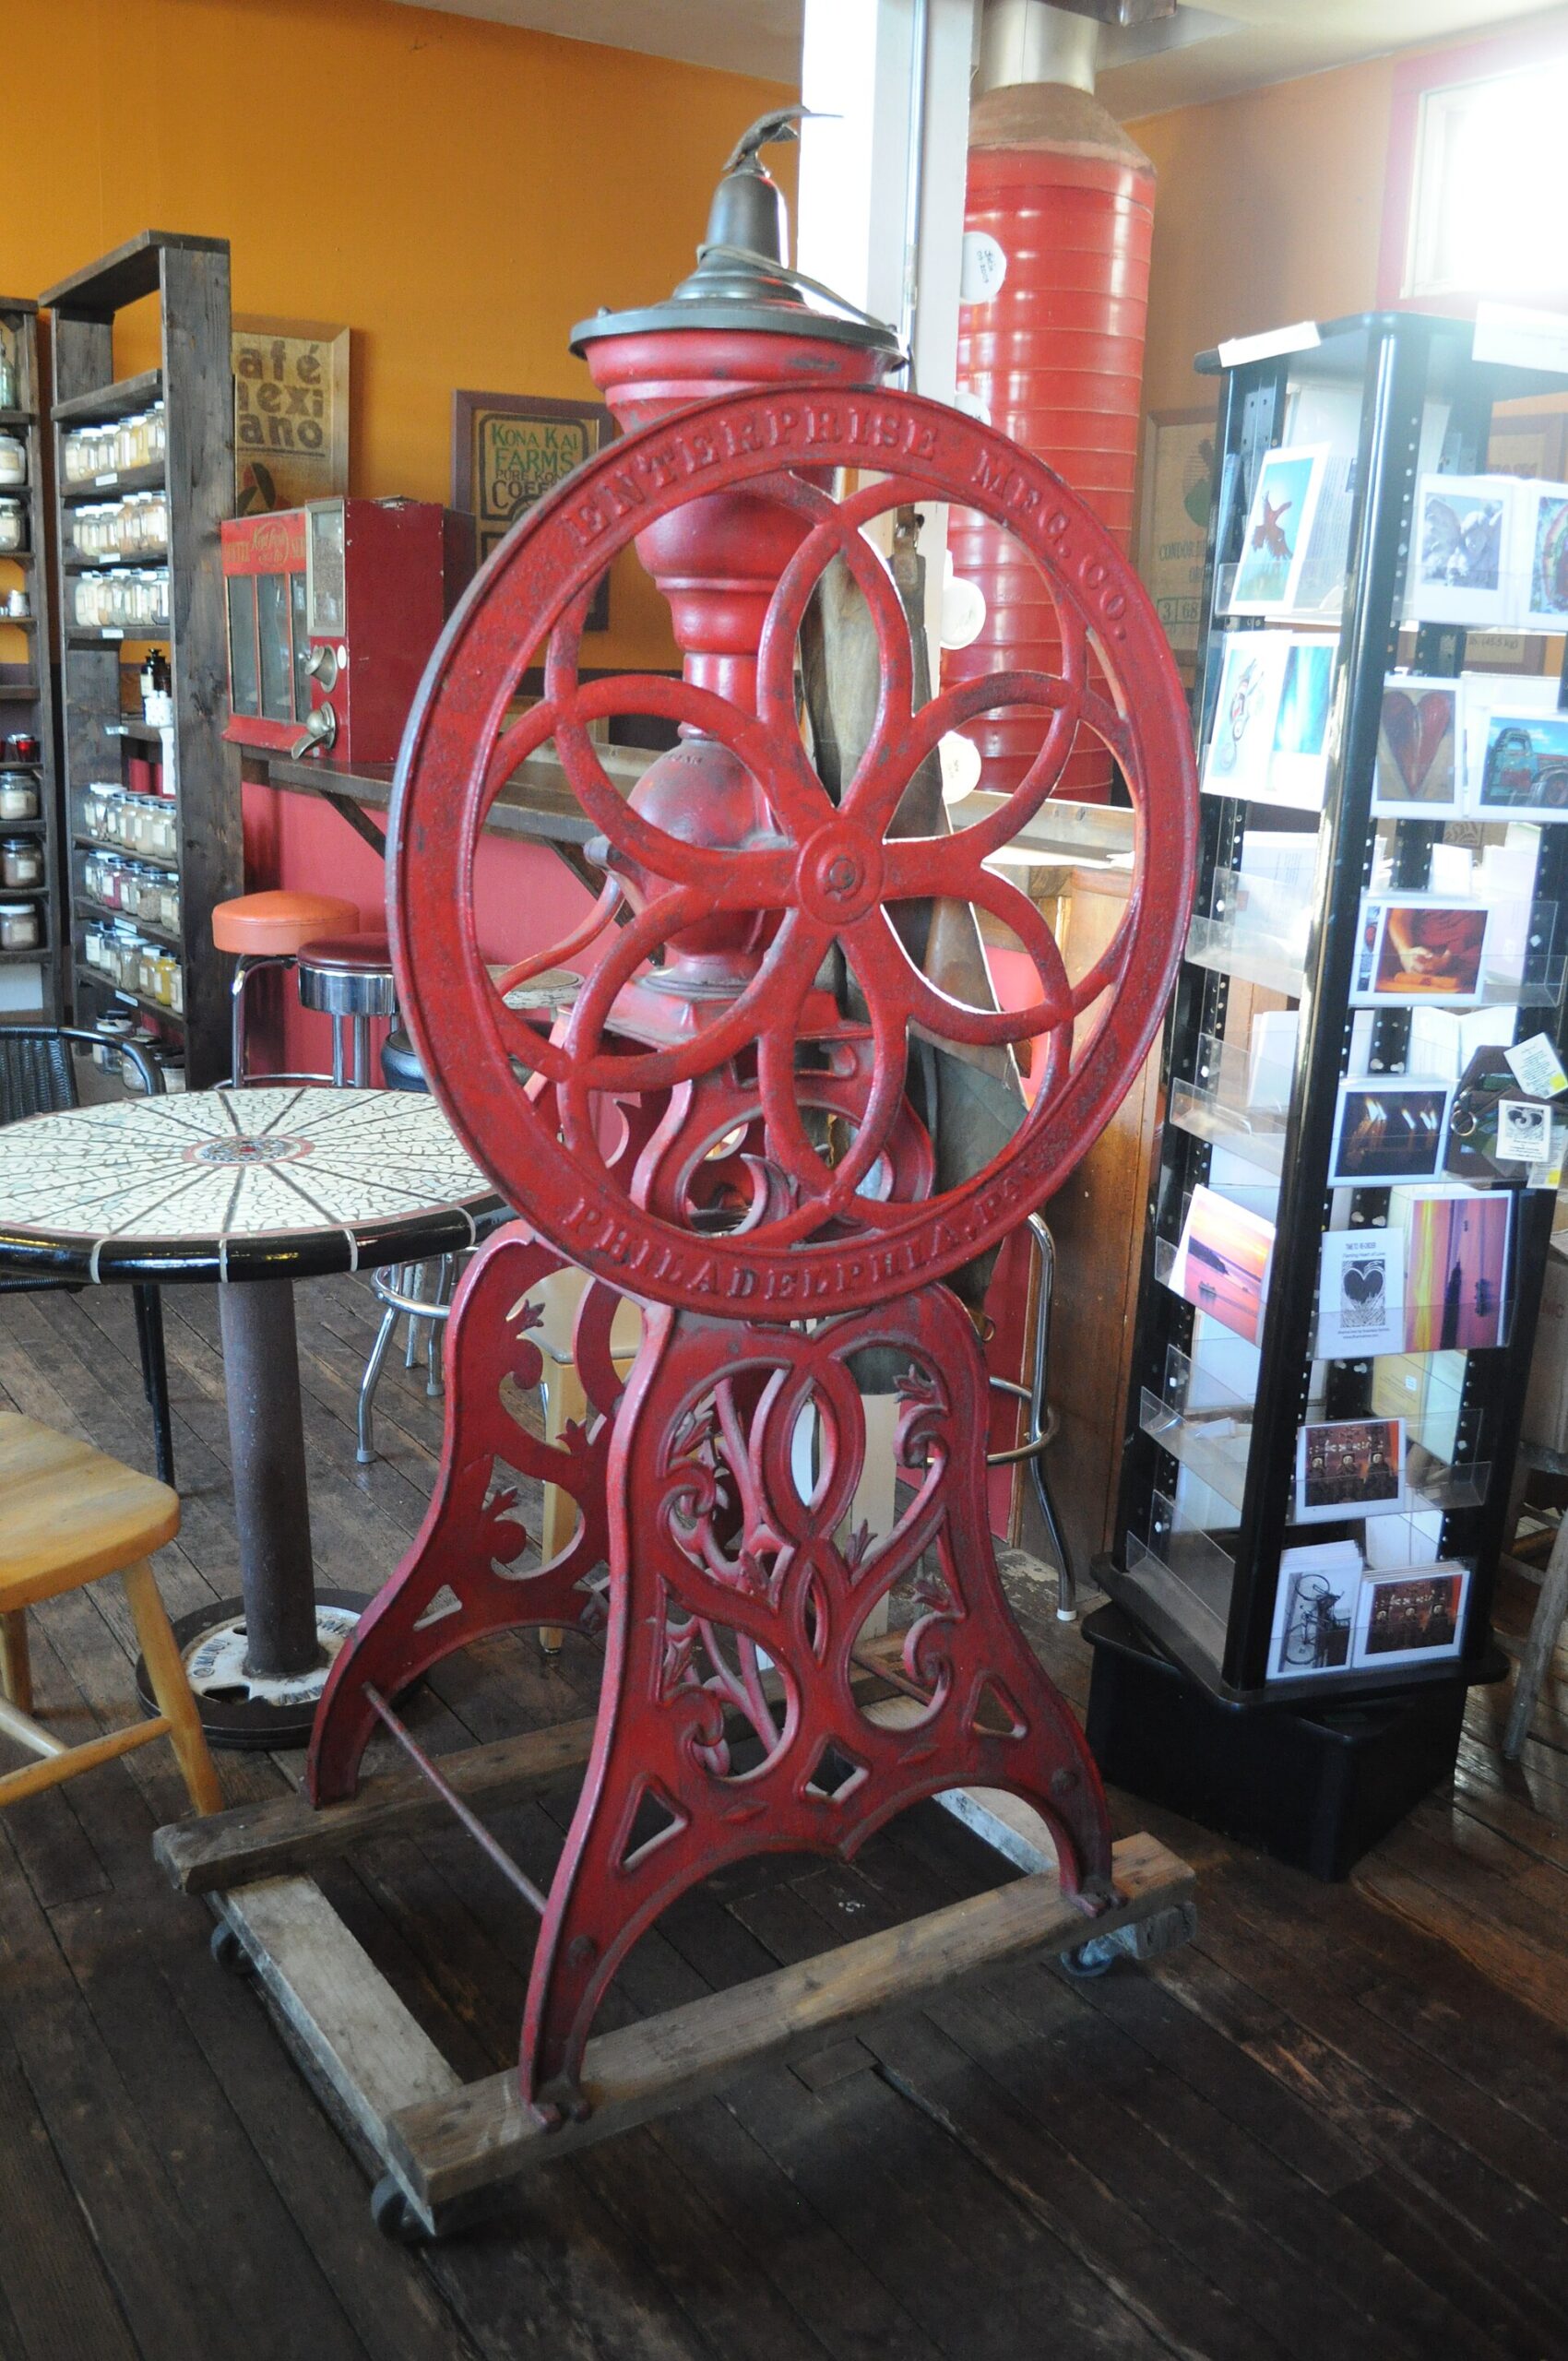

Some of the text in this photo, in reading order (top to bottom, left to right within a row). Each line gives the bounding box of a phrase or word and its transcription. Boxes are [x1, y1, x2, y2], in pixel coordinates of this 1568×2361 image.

[238, 339, 322, 386] afé
[491, 423, 578, 451] KONA KAI
[495, 447, 576, 474] FARMS
[561, 405, 939, 547] ENTERPRISE
[970, 448, 1070, 559] MFG.
[1077, 553, 1127, 642] CO.
